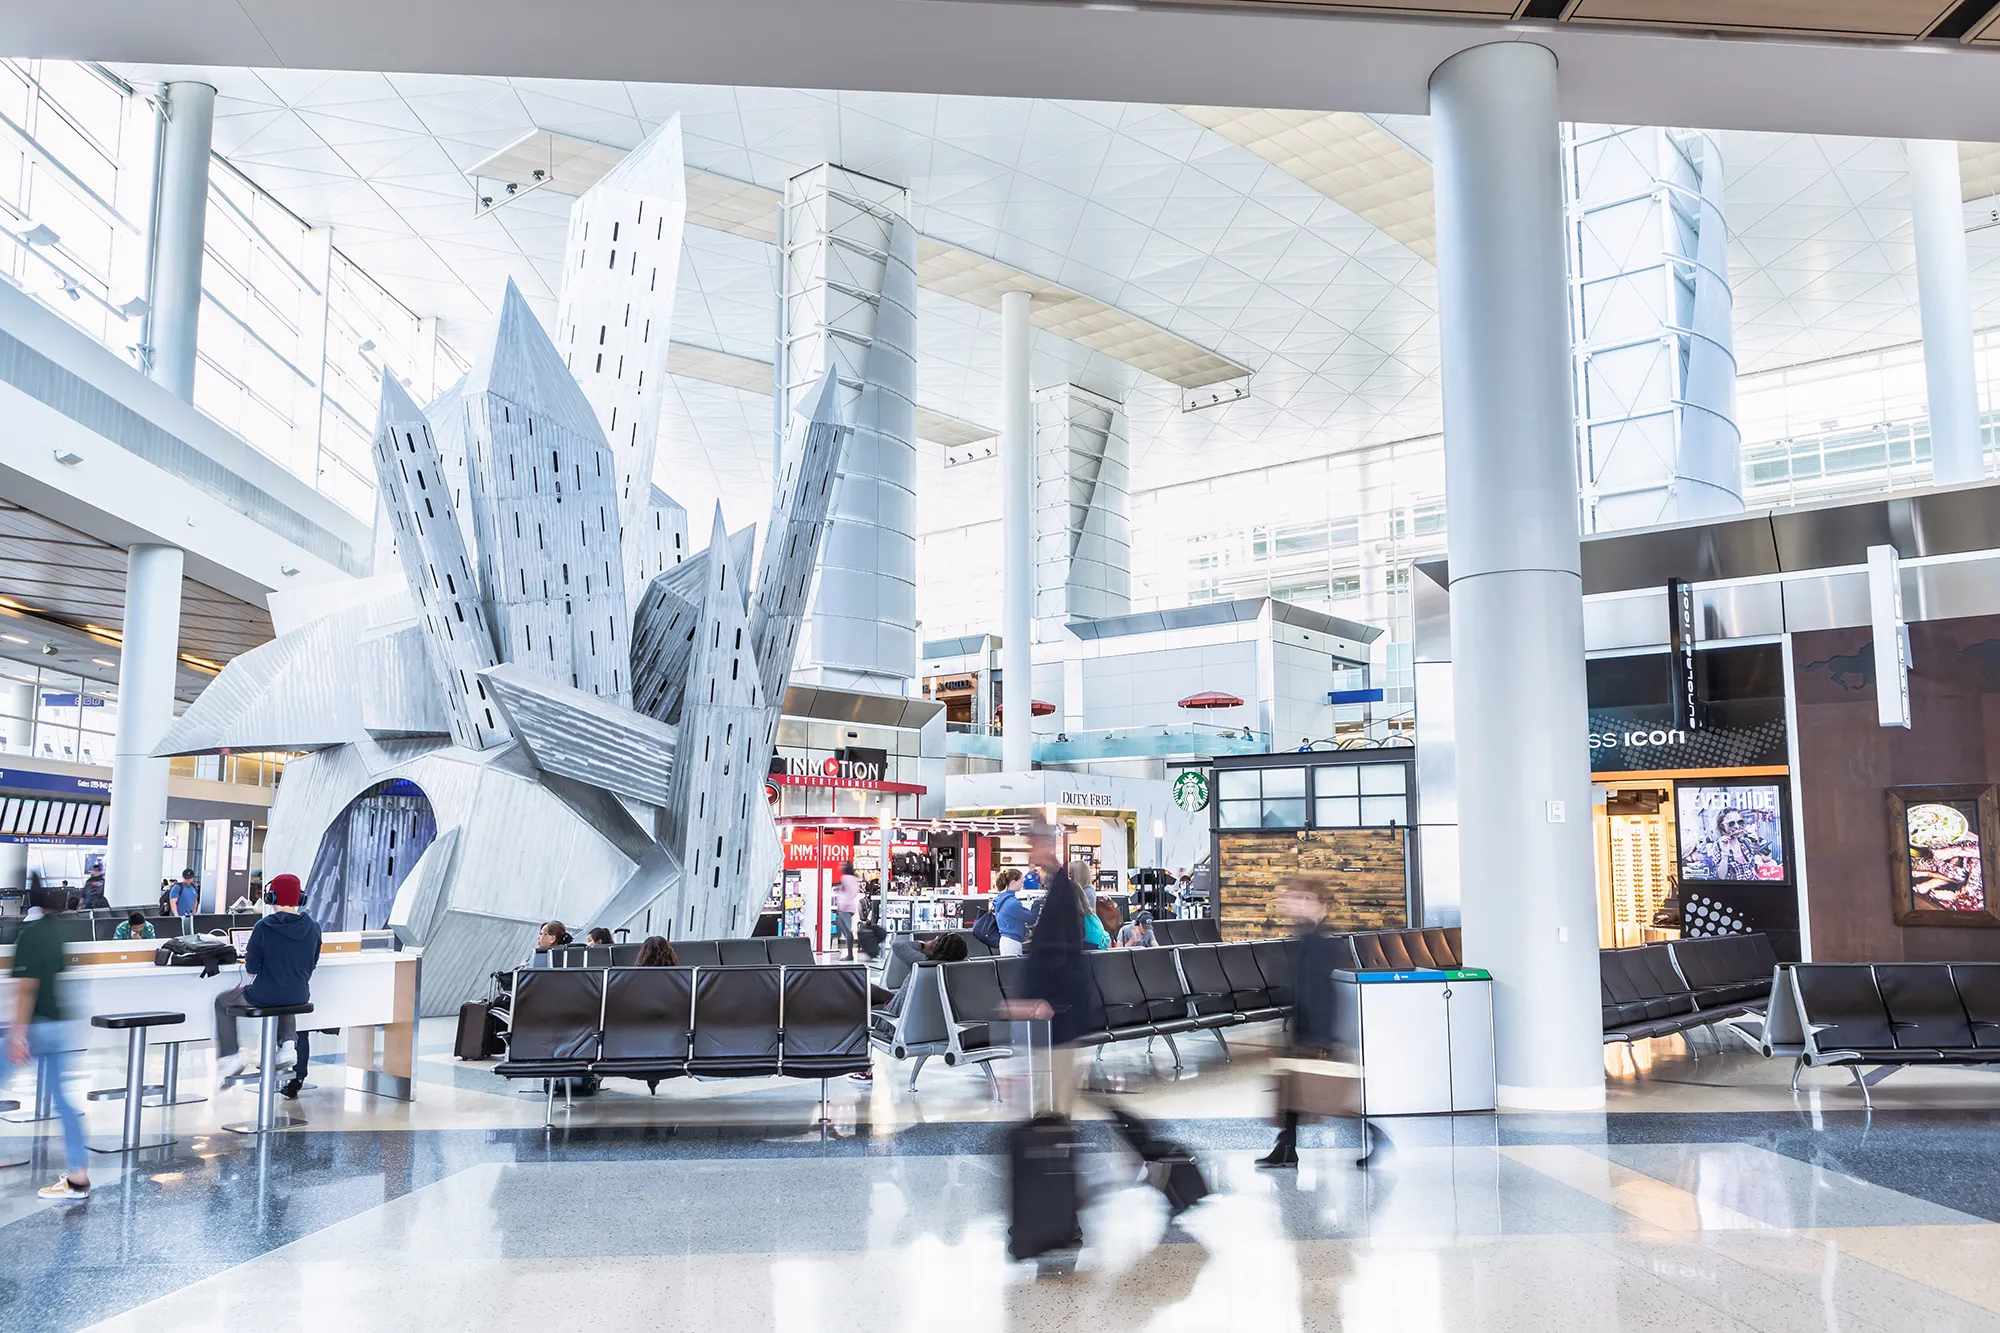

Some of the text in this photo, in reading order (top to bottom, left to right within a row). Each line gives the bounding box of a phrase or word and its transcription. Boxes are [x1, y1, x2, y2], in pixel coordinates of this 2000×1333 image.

[945, 679, 972, 690] GRILL
[786, 776, 879, 789] ENTERTAINMENT
[1062, 791, 1112, 806] DUTY FREE
[1736, 790, 1775, 810] HIDE
